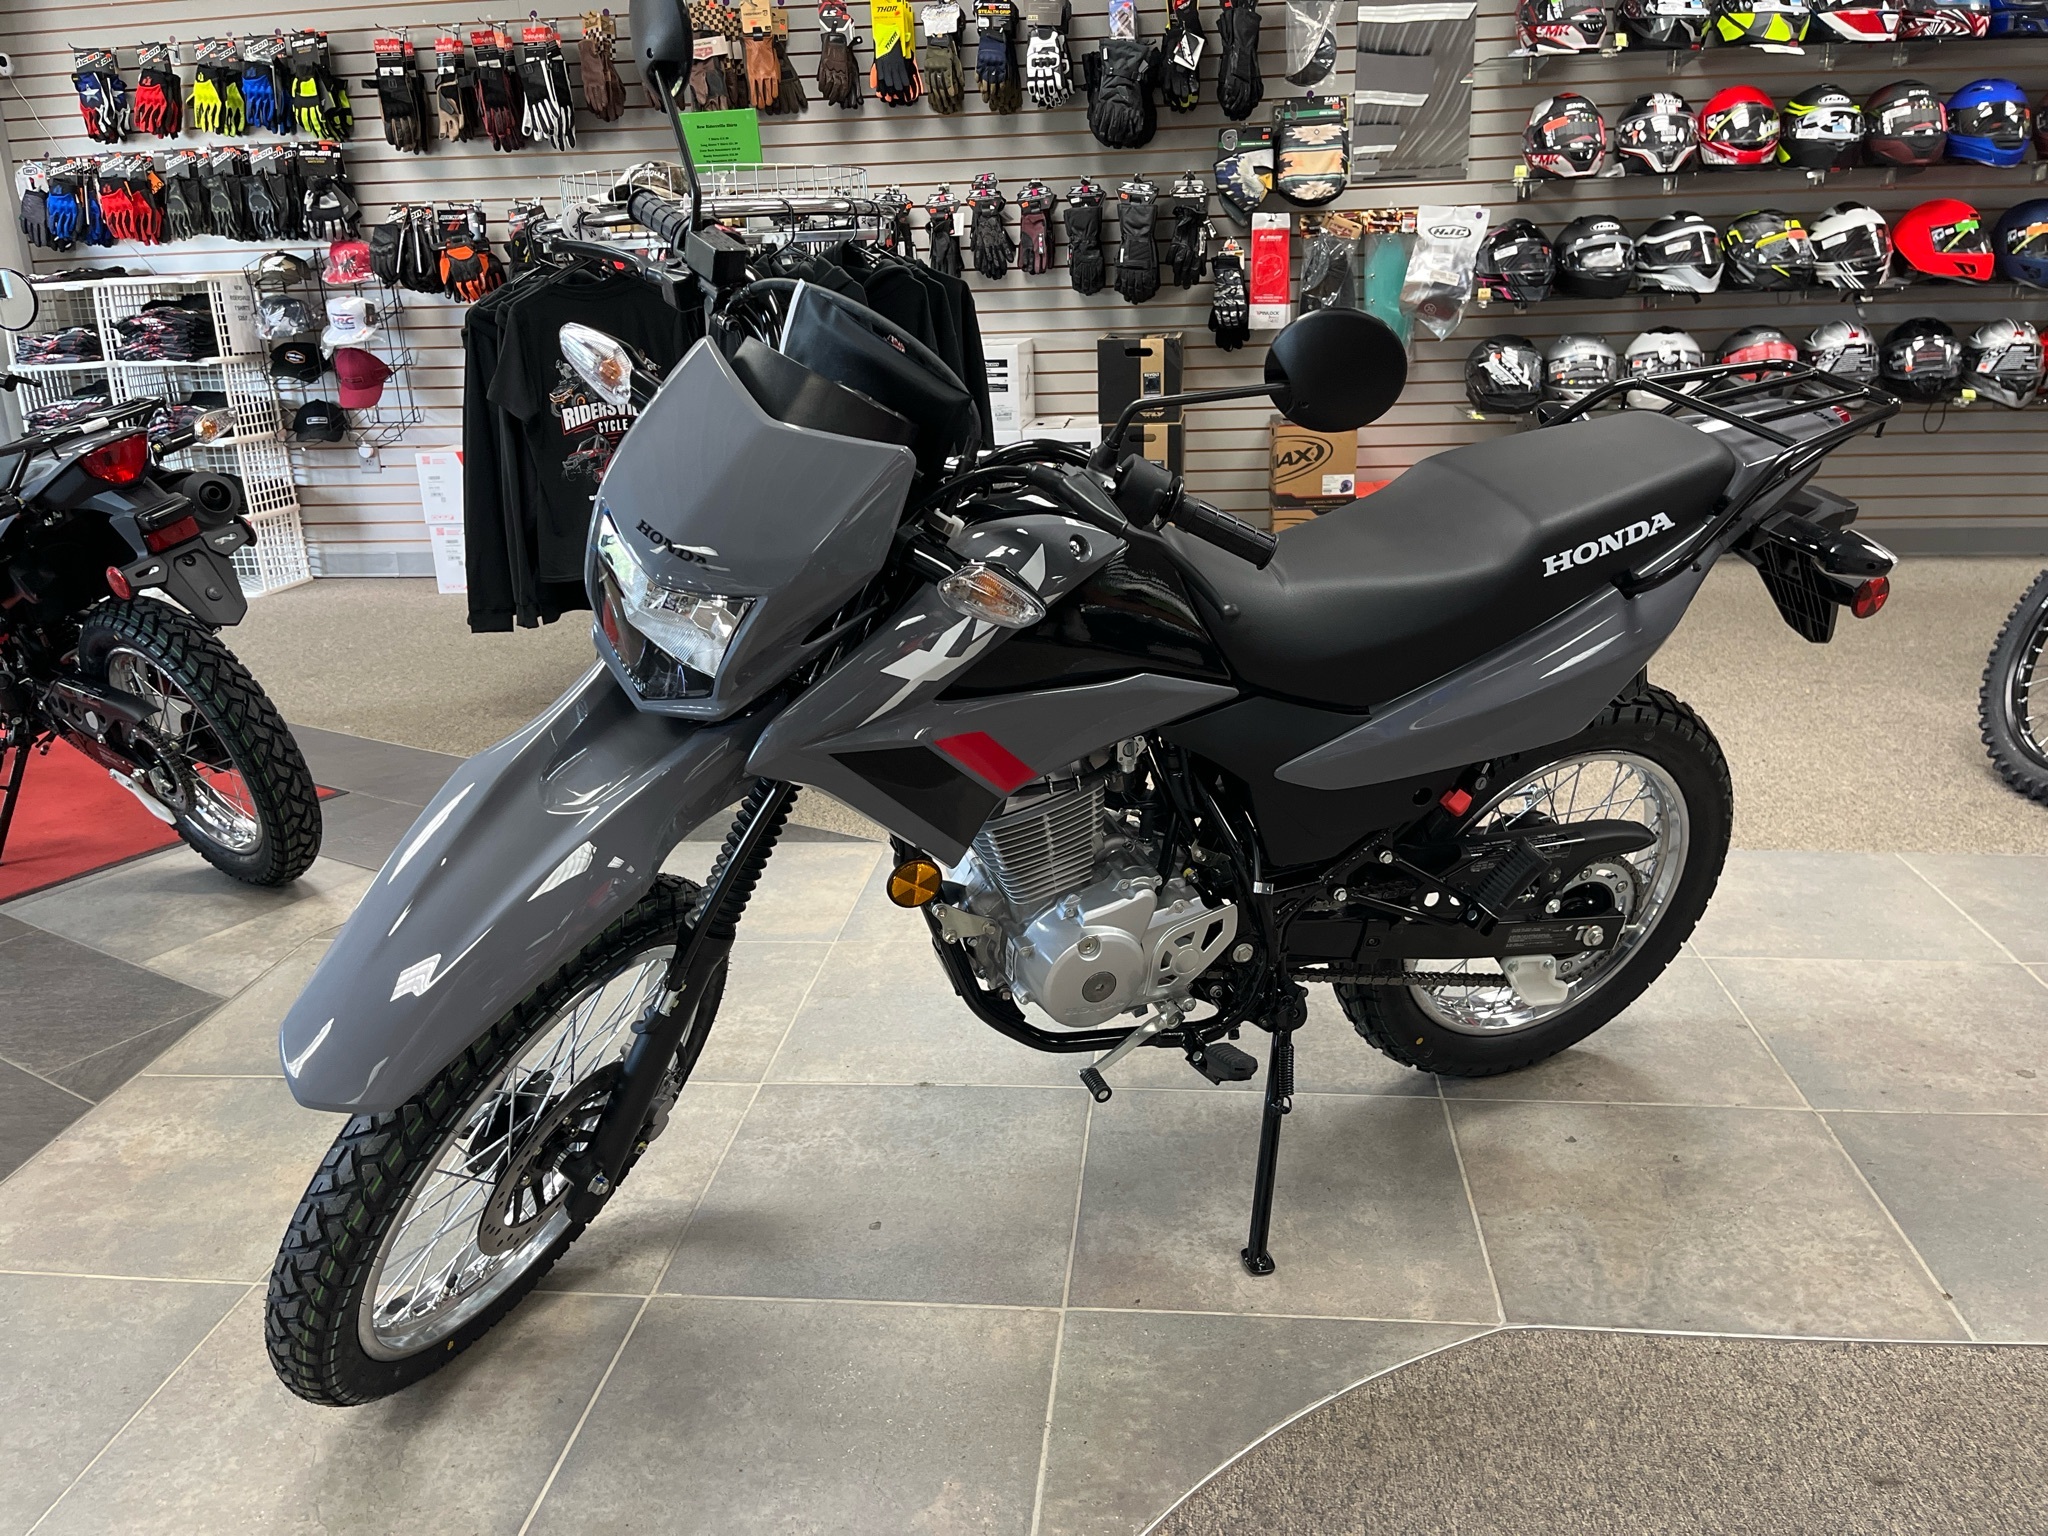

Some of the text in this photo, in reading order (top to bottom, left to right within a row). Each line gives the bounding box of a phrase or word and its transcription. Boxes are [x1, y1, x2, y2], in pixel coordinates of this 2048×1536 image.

[885, 31, 899, 50] THOR
[220, 46, 236, 60] con
[269, 42, 285, 56] con
[1323, 96, 1340, 104] ZAN
[1433, 228, 1467, 237] HJC
[561, 402, 640, 431] RIDERSVIL
[597, 418, 629, 434] CYCLE
[635, 518, 712, 572] HONDA
[1542, 511, 1676, 578] HONDA
